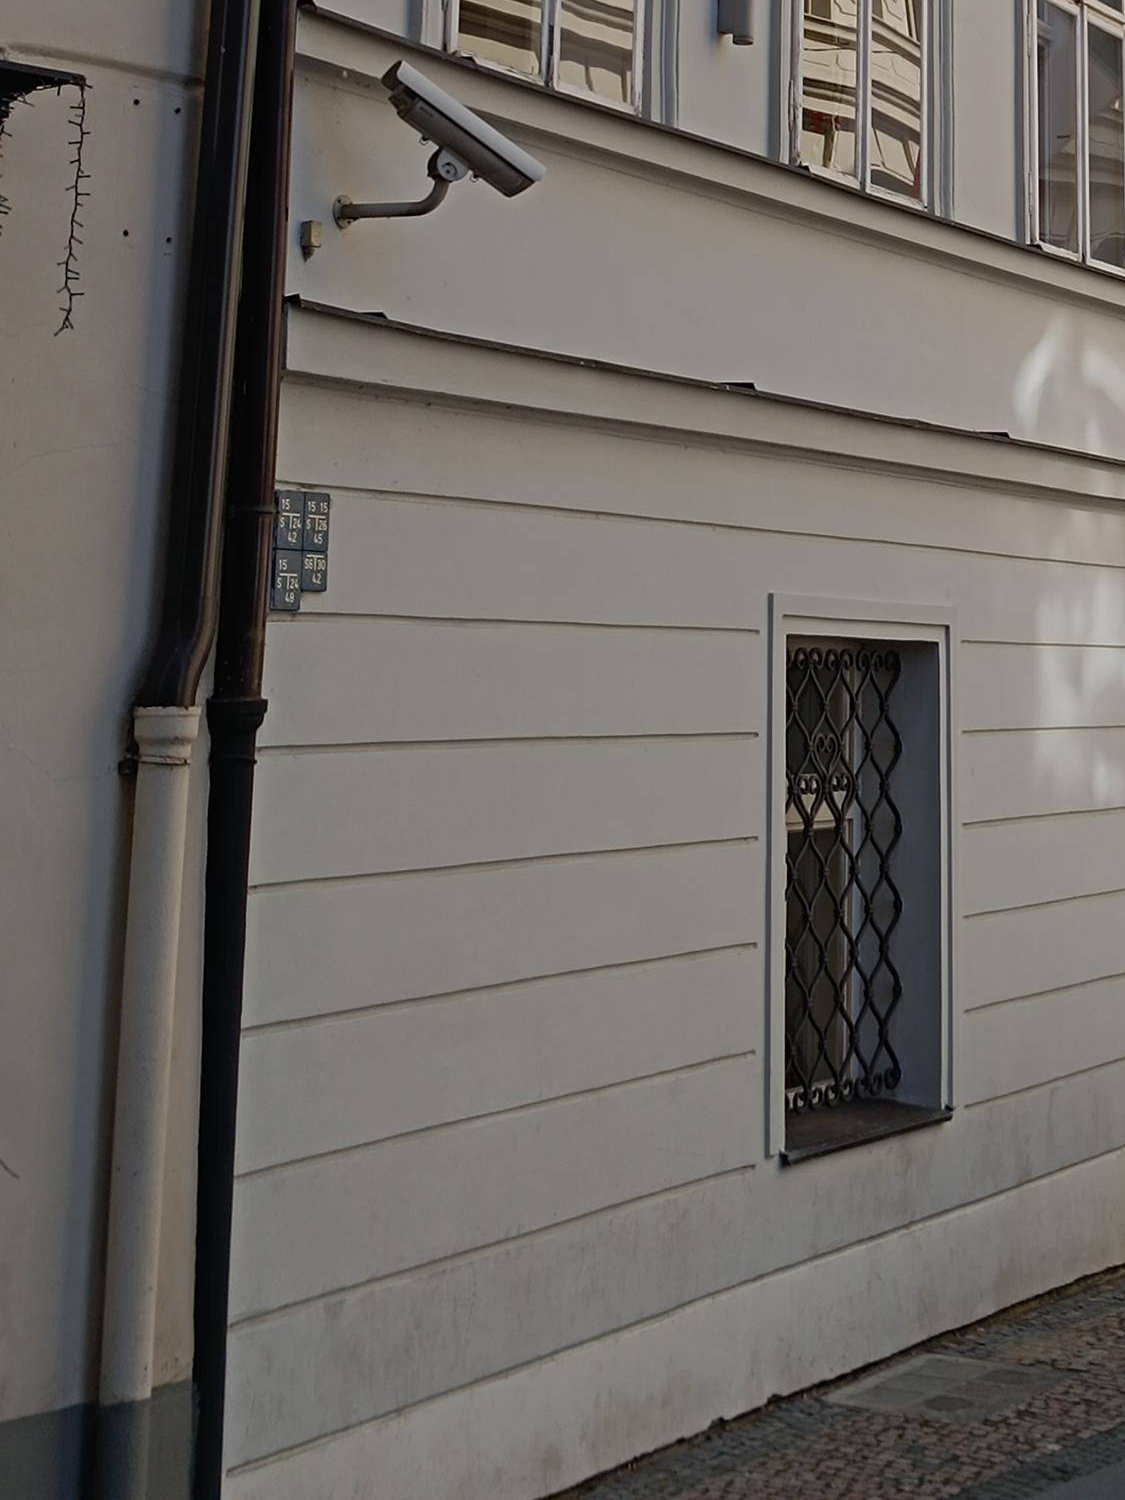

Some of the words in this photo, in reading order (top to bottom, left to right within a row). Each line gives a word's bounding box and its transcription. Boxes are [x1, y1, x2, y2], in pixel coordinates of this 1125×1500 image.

[287, 532, 297, 543] 42
[313, 533, 323, 545] 45
[312, 573, 322, 584] 42
